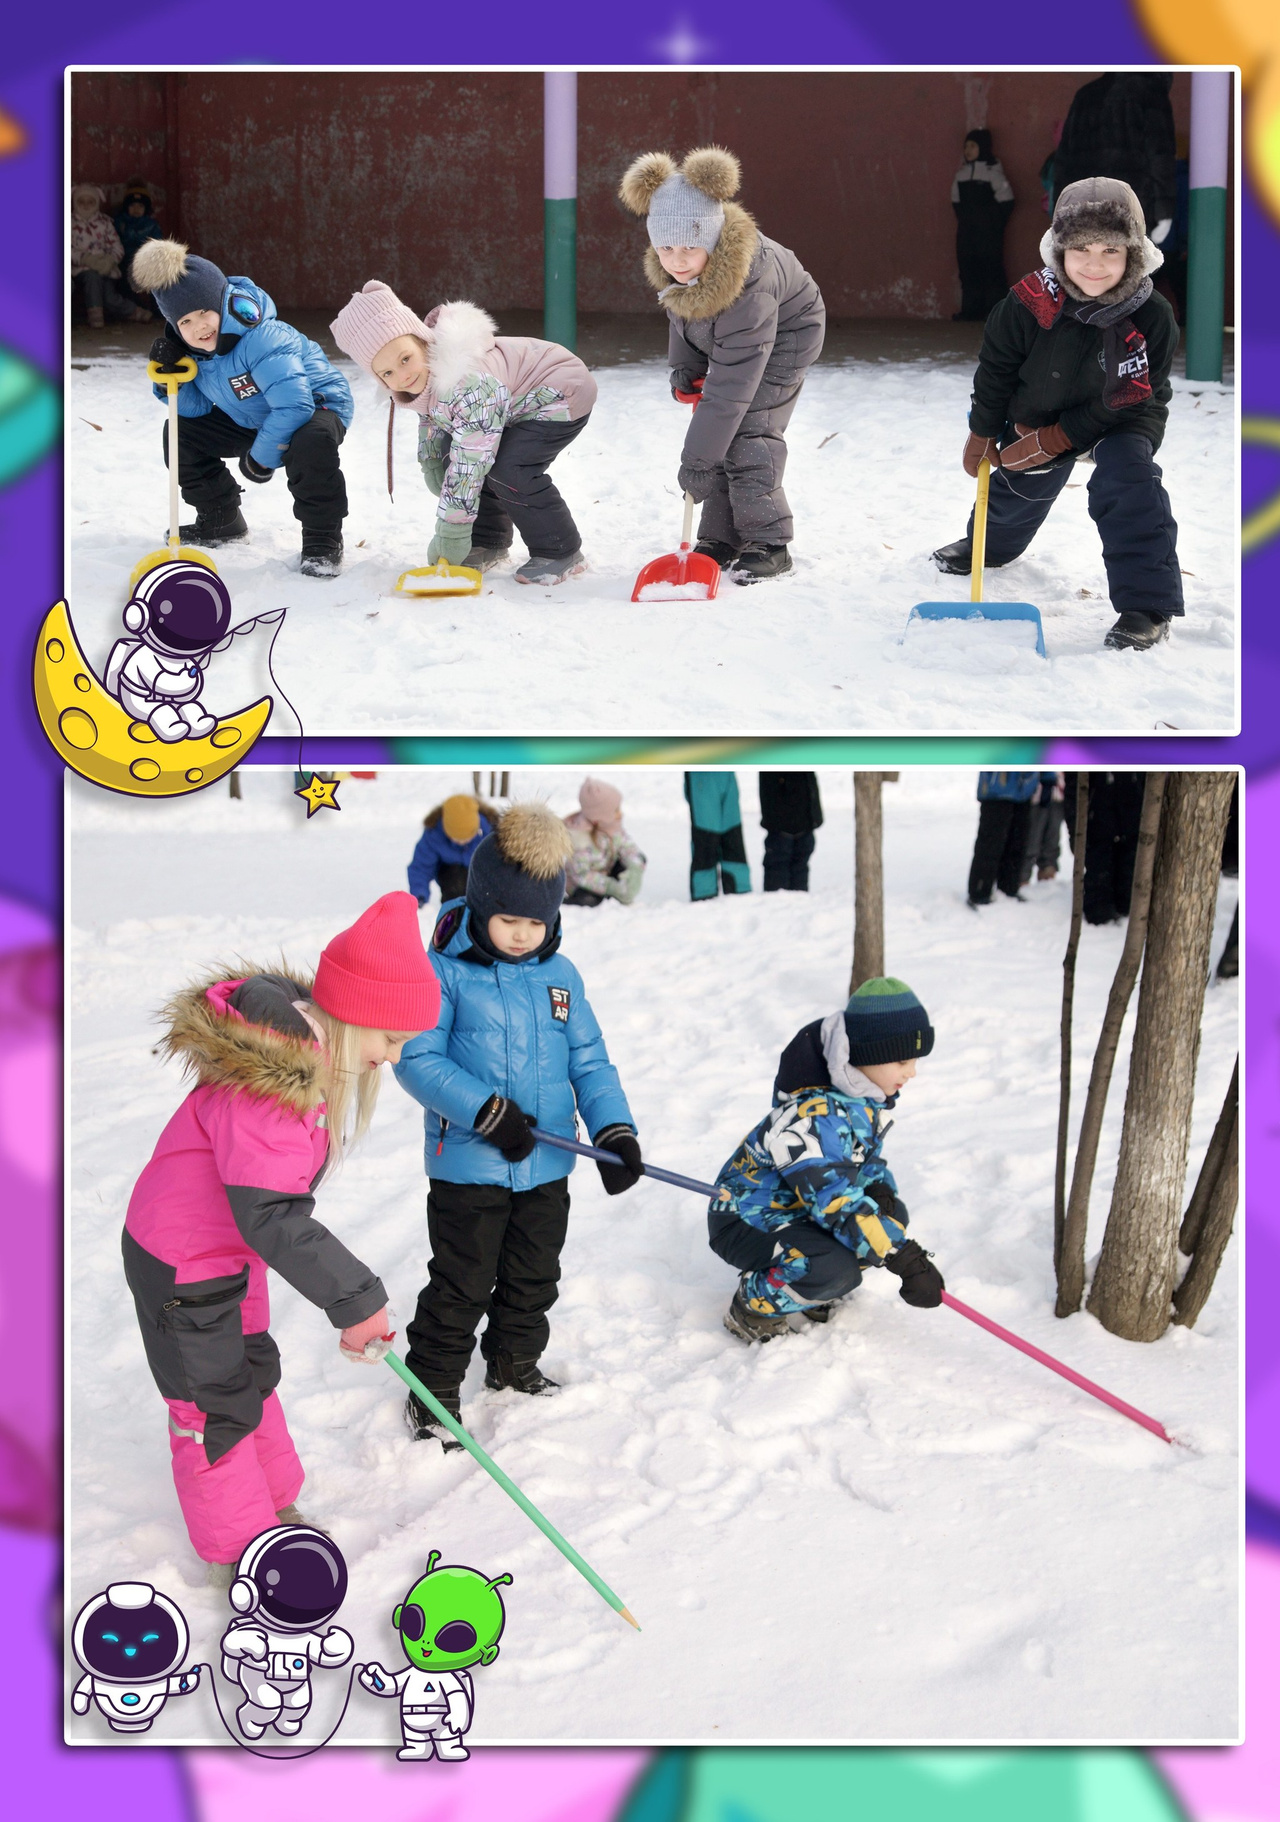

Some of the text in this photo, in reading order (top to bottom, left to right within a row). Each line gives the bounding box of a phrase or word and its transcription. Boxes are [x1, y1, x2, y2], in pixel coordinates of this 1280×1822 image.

[231, 374, 248, 389] ST
[240, 385, 258, 400] AR
[551, 988, 569, 1004] ST
[555, 1005, 569, 1022] AR
